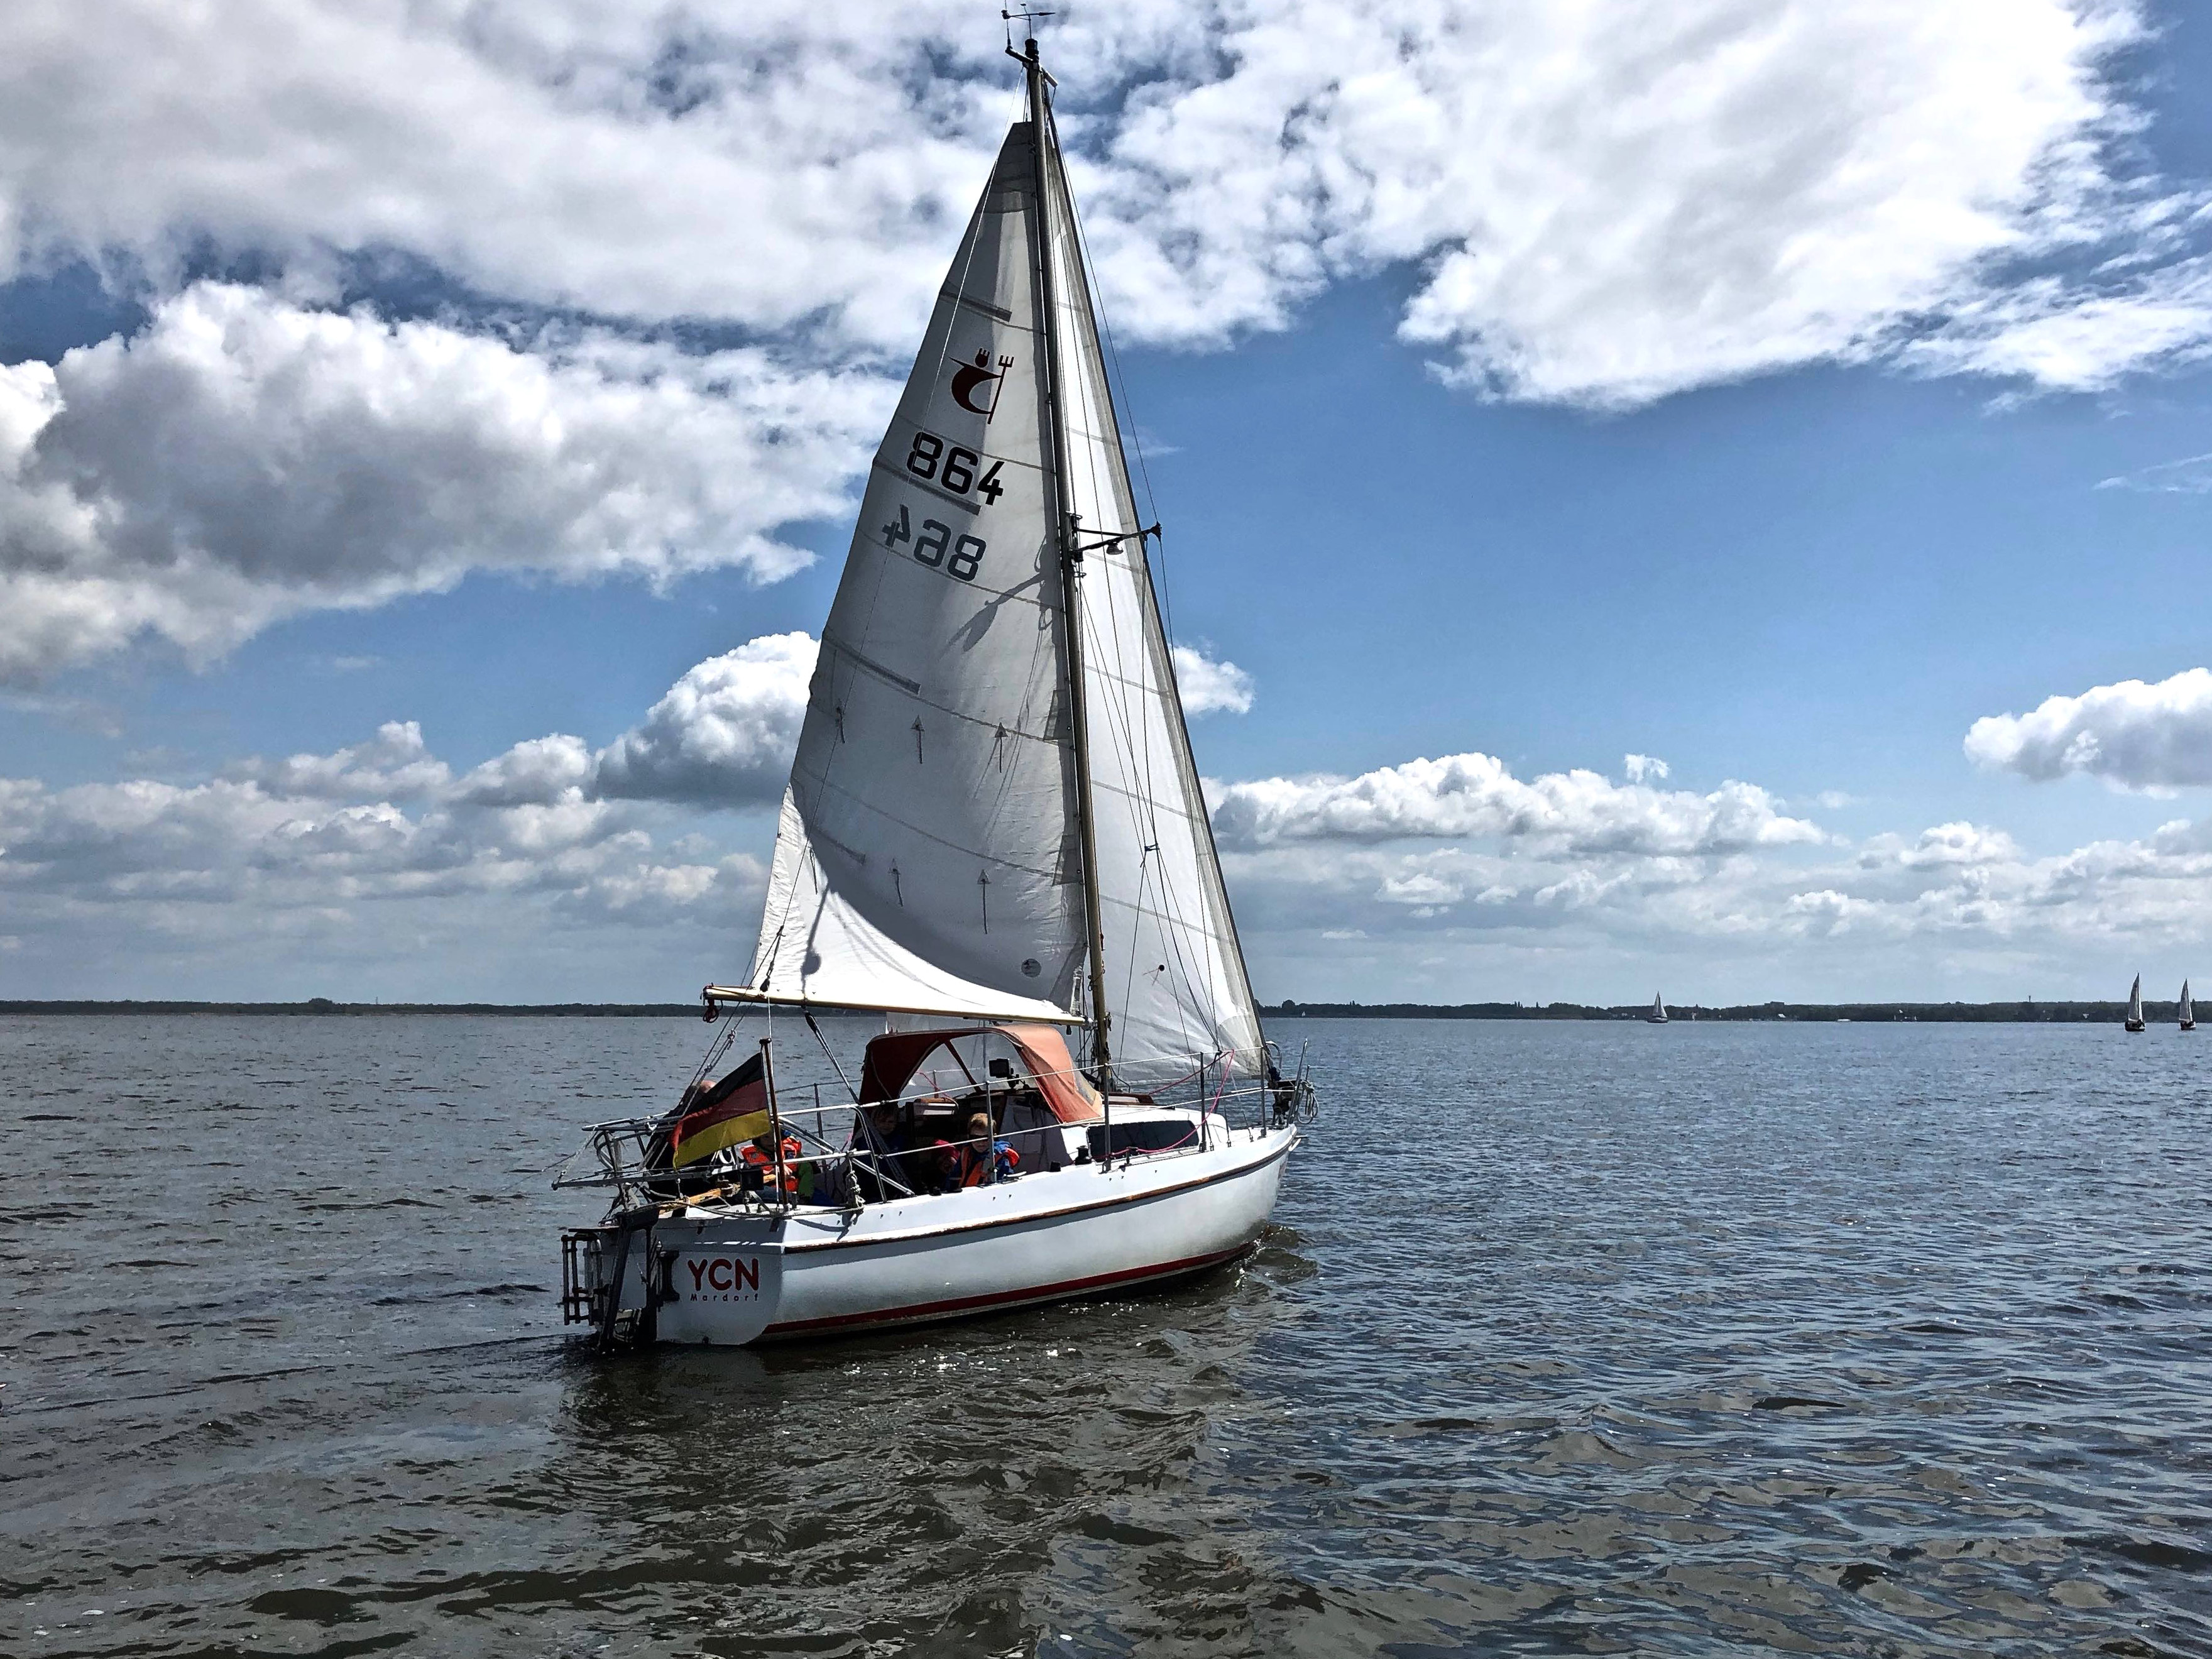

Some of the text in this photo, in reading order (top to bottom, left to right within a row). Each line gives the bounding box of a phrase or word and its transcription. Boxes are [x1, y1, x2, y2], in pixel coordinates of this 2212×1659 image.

[907, 432, 1005, 505] 864
[687, 1258, 759, 1291] YCN
[691, 1293, 758, 1301] Mardorf
